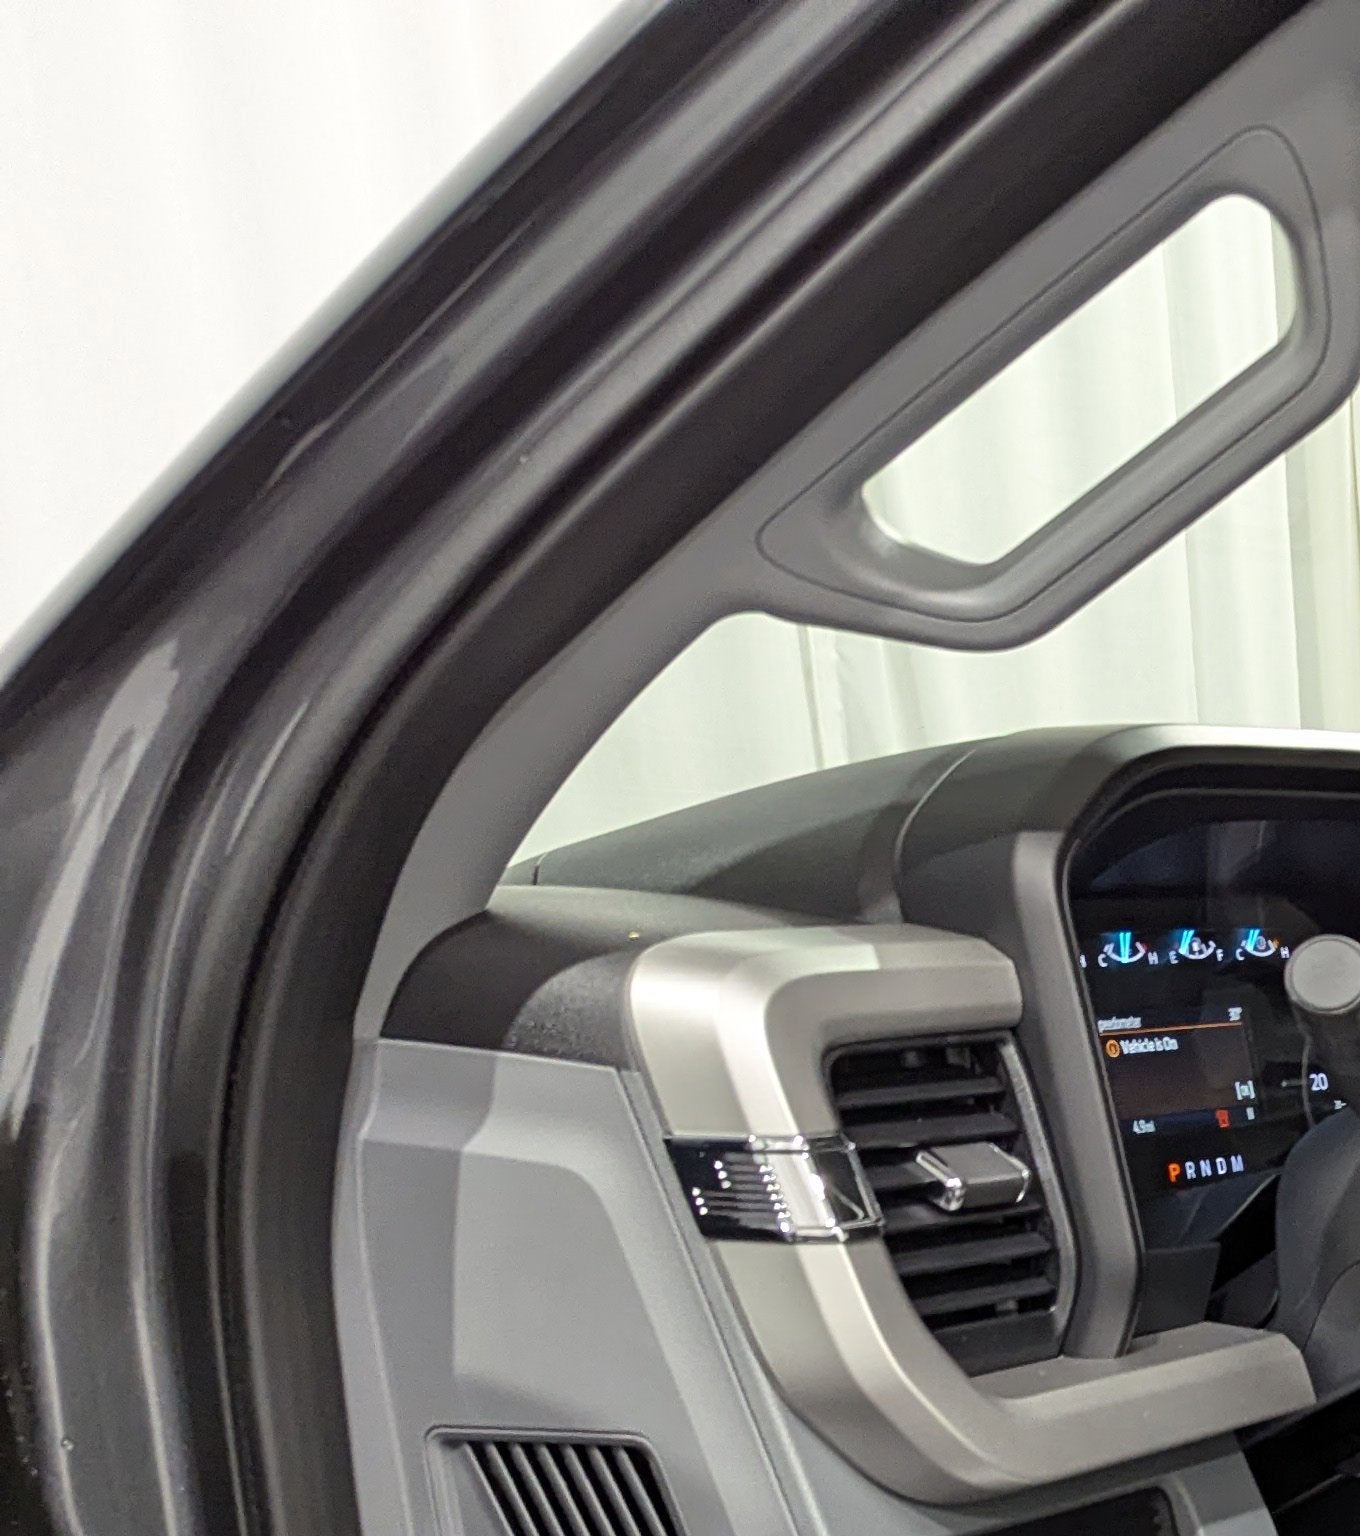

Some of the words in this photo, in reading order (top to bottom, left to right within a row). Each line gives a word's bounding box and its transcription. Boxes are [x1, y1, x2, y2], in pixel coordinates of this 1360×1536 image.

[1309, 1073, 1328, 1091] 20
[1168, 1163, 1181, 1182] P
[1185, 1161, 1197, 1180] R
[1200, 1159, 1212, 1177] N
[1216, 1157, 1227, 1175] D
[1230, 1154, 1245, 1173] M
